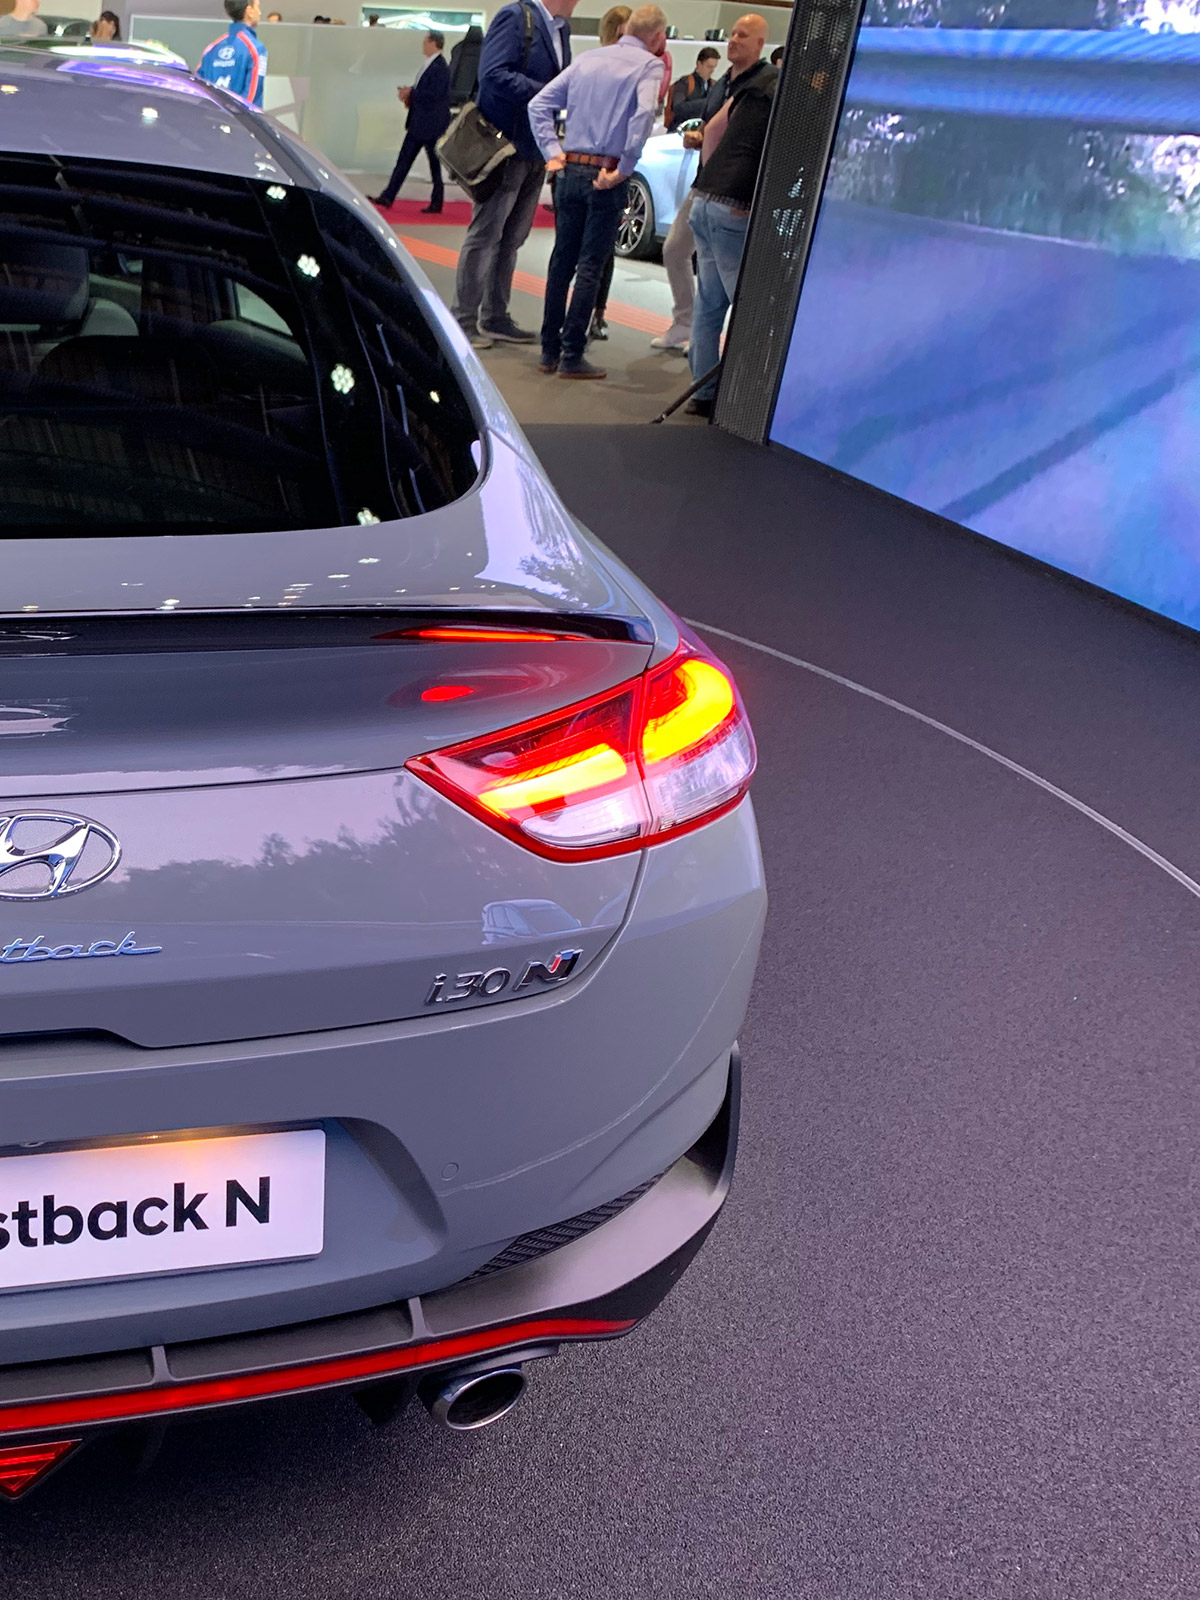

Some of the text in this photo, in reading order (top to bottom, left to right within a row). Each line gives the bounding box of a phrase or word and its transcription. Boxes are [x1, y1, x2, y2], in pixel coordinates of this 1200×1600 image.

[425, 949, 584, 1004] i30 N
[225, 1176, 271, 1228] N
